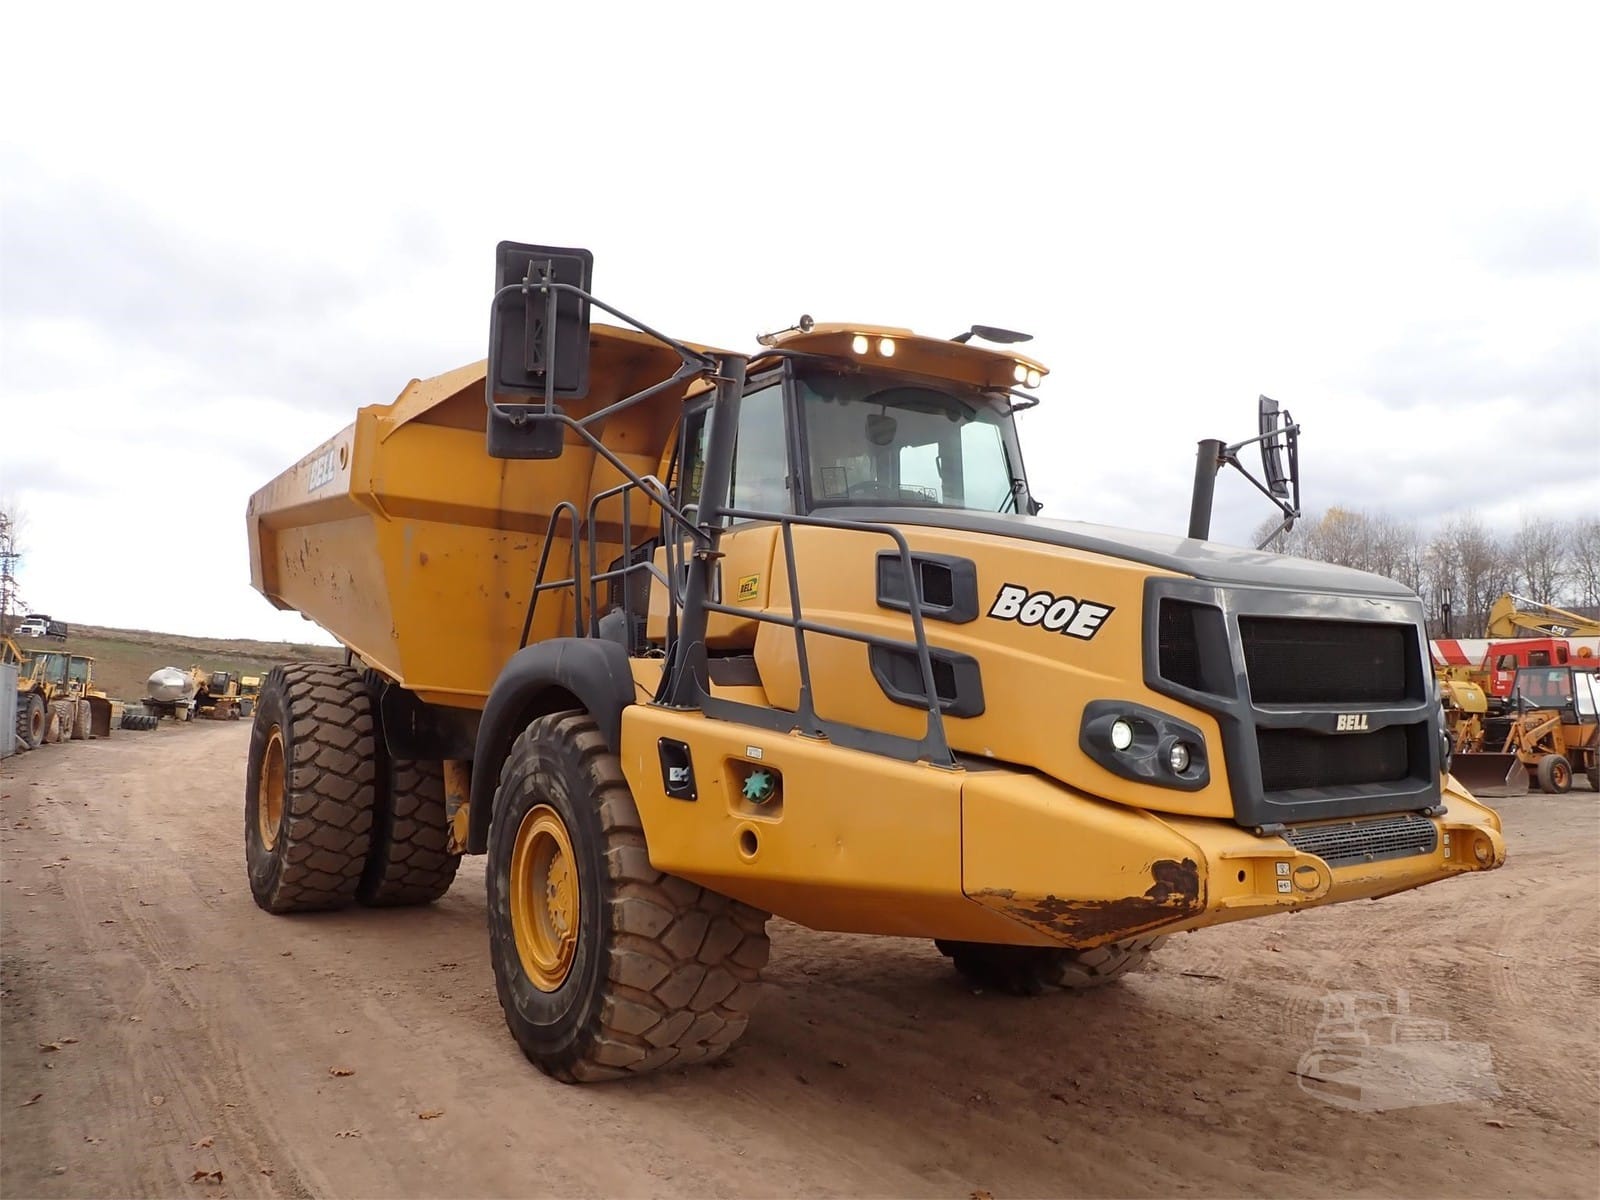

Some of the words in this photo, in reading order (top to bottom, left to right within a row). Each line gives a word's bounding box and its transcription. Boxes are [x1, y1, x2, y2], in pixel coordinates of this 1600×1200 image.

[740, 583, 753, 593] BELL
[987, 583, 1115, 640] B60E
[1551, 625, 1567, 636] CAT
[1336, 714, 1369, 730] BELL
